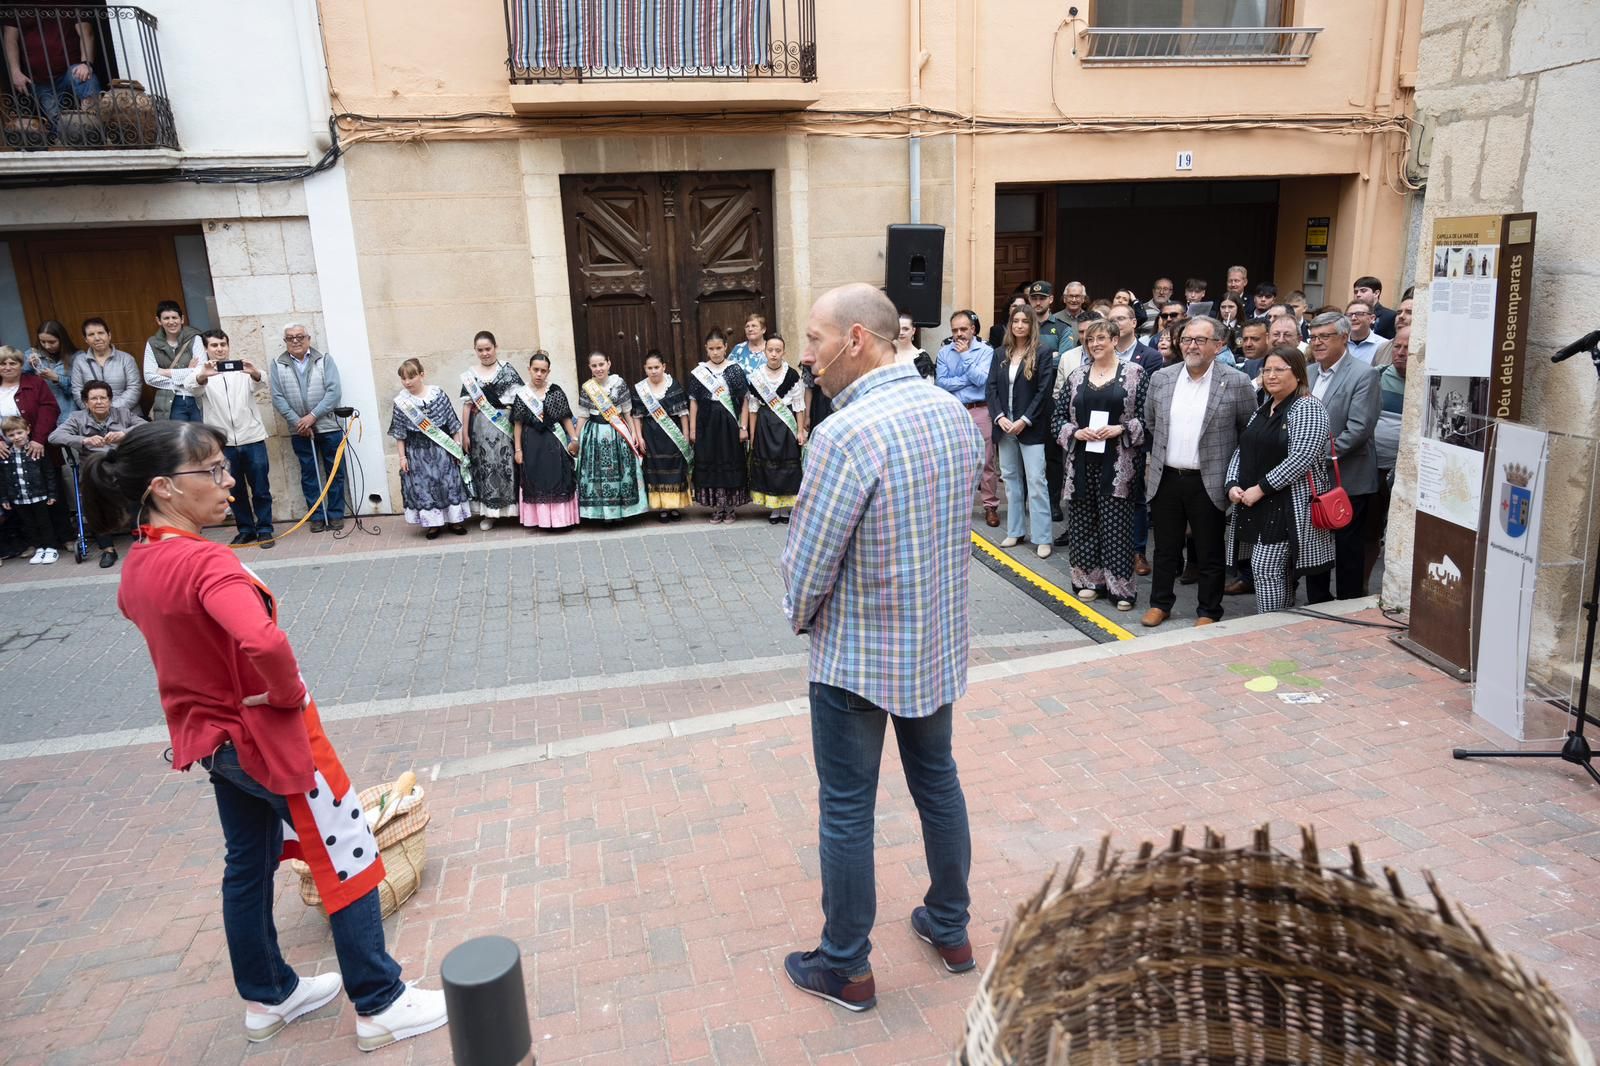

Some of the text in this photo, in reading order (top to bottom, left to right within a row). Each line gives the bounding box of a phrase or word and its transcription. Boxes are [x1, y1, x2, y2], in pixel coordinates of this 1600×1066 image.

[1179, 153, 1191, 167] 19
[1497, 255, 1522, 417] Déu dels Desemparats
